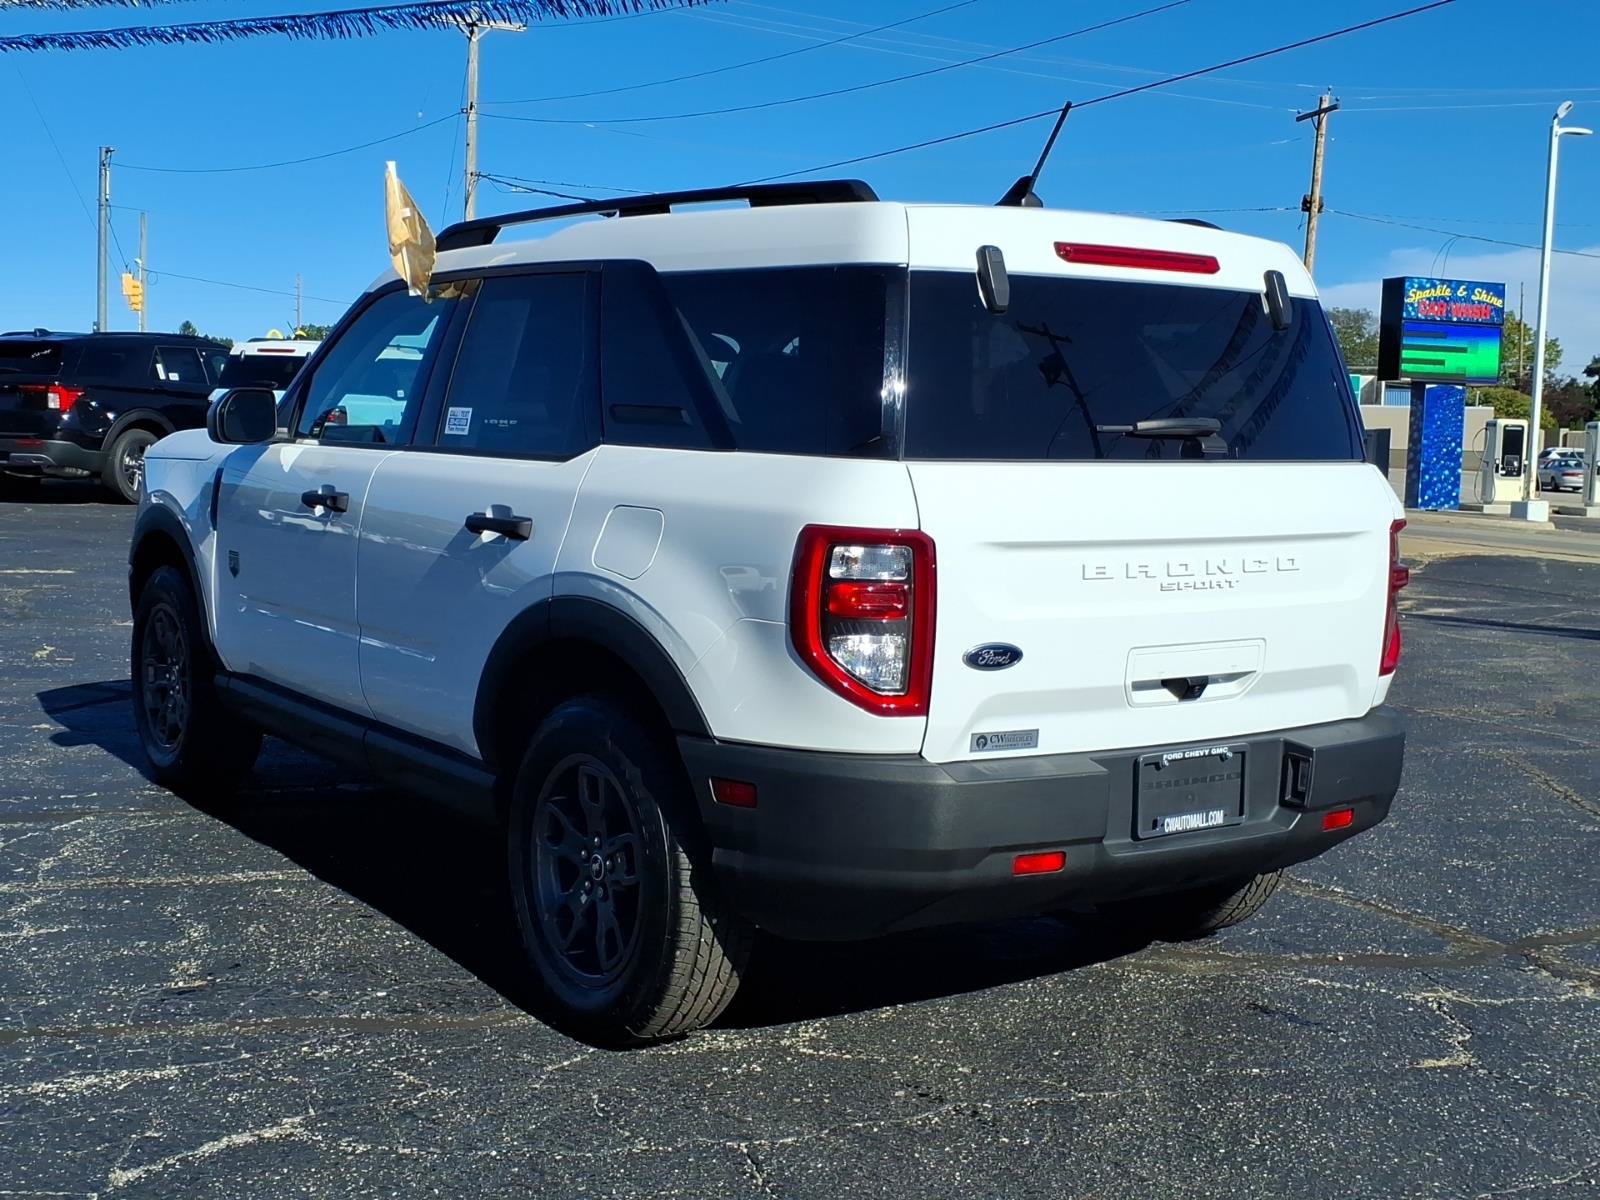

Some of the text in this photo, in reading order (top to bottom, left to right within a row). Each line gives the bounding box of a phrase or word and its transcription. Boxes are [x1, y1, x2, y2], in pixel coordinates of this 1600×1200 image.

[1407, 284, 1504, 307] Sparkle & Shine
[1419, 300, 1491, 319] CAR WASH
[1082, 557, 1300, 580] BRONCO
[1160, 578, 1239, 592] SPORT
[977, 649, 1011, 665] Ford
[1163, 747, 1229, 761] FORD CHEVY GMC
[1164, 810, 1224, 833] CWAUTOMALL.COM
